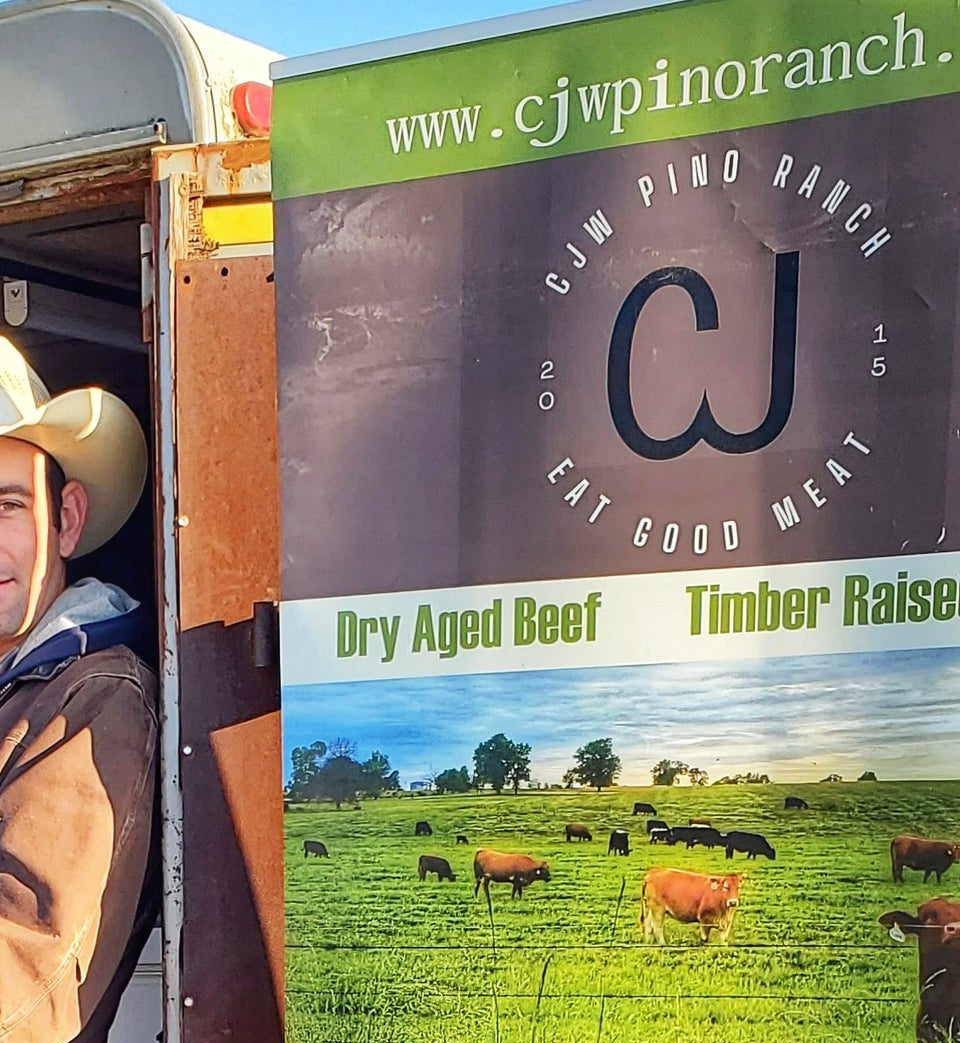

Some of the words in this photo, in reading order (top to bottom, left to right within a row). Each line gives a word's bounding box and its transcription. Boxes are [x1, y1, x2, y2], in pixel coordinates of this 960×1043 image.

[545, 208, 614, 295] CJW
[637, 149, 739, 208] PINO
[772, 153, 891, 259] RANCH
[547, 457, 611, 524] EAT
[633, 517, 739, 554] GOOD
[771, 431, 871, 532] MEAT
[336, 610, 401, 663] Dry
[411, 598, 502, 659] Aged
[514, 592, 602, 646] Beef
[685, 582, 830, 636] Timber
[843, 571, 960, 627] Raise
